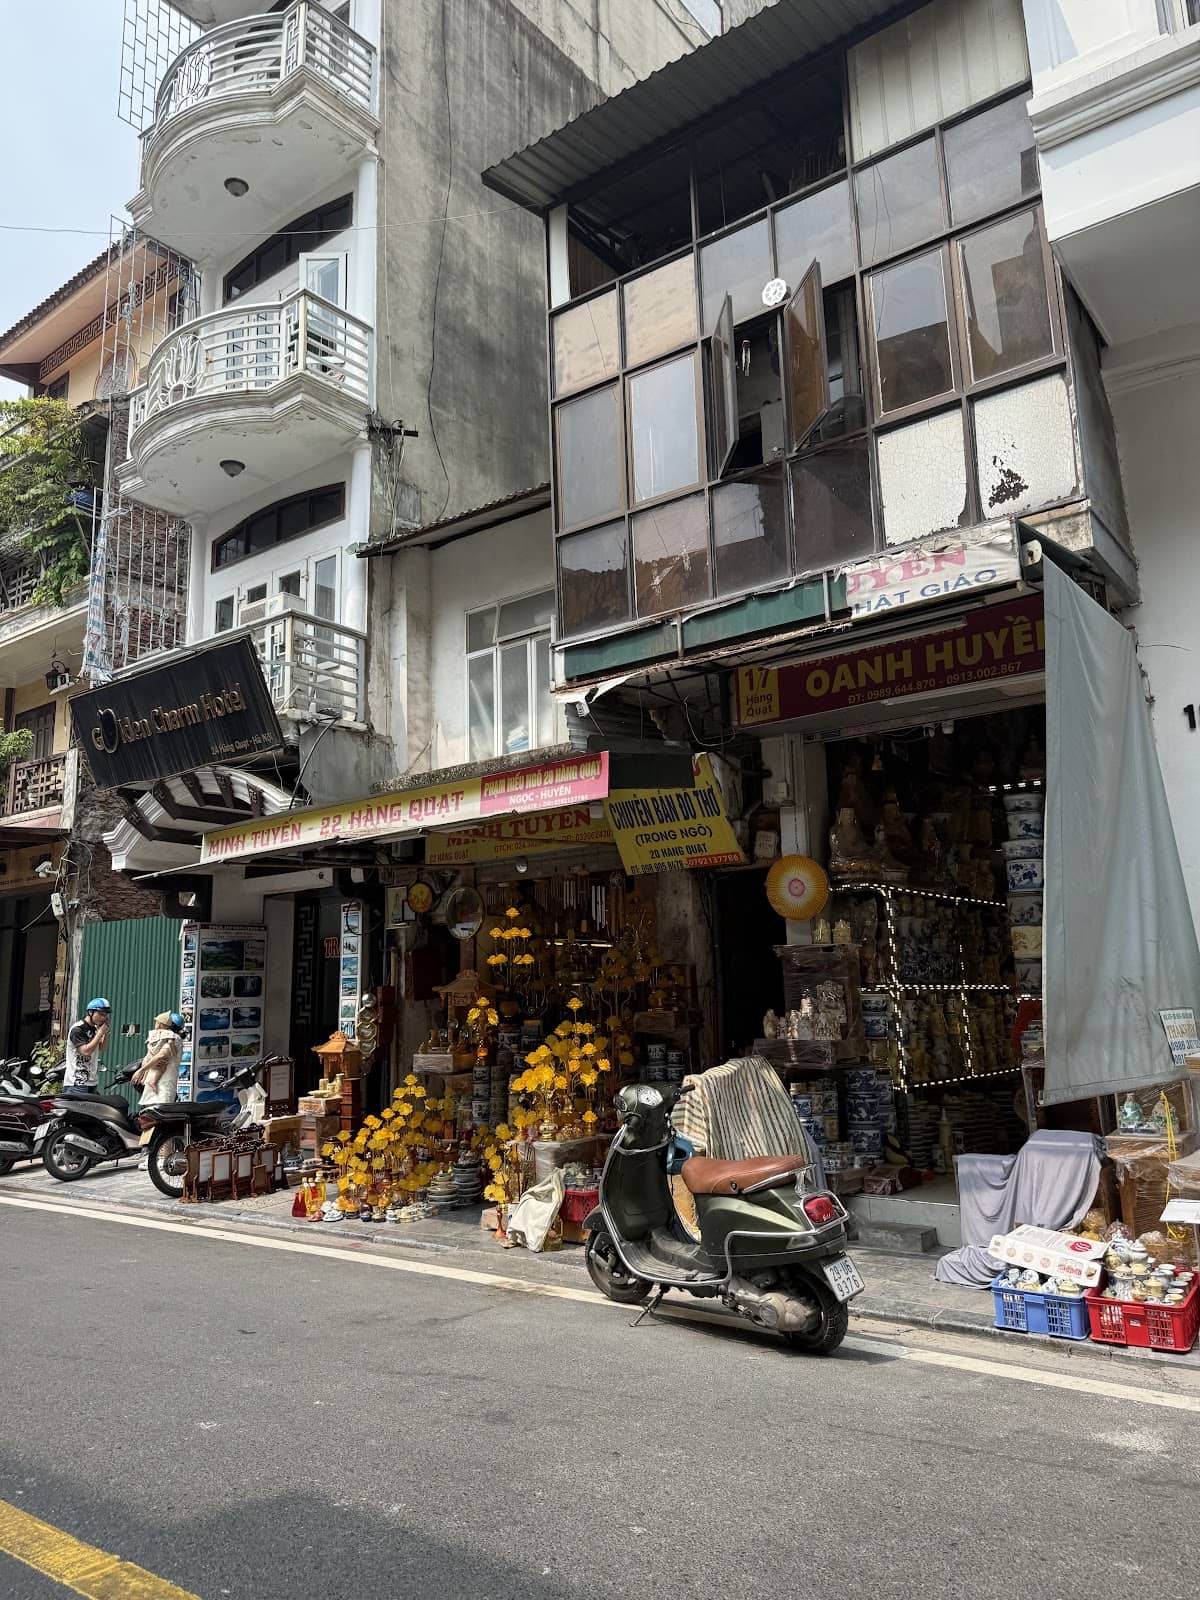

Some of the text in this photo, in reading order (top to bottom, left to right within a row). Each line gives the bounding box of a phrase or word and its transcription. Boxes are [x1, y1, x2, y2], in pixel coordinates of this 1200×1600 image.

[920, 568, 997, 597] GIÁO
[805, 648, 912, 698] OANH
[926, 614, 1044, 673] HUYỀ
[745, 667, 770, 690] 17
[866, 677, 936, 702] 0989.644.870
[946, 661, 1022, 686] 0913.002.867
[151, 703, 200, 734] Charm
[200, 683, 247, 720] Hotel
[208, 835, 246, 857] MINH
[319, 815, 343, 836] 22
[347, 803, 401, 830] HÀNG
[408, 790, 465, 824] QUẠT
[635, 829, 677, 847] (TRONG
[650, 850, 660, 859] 20
